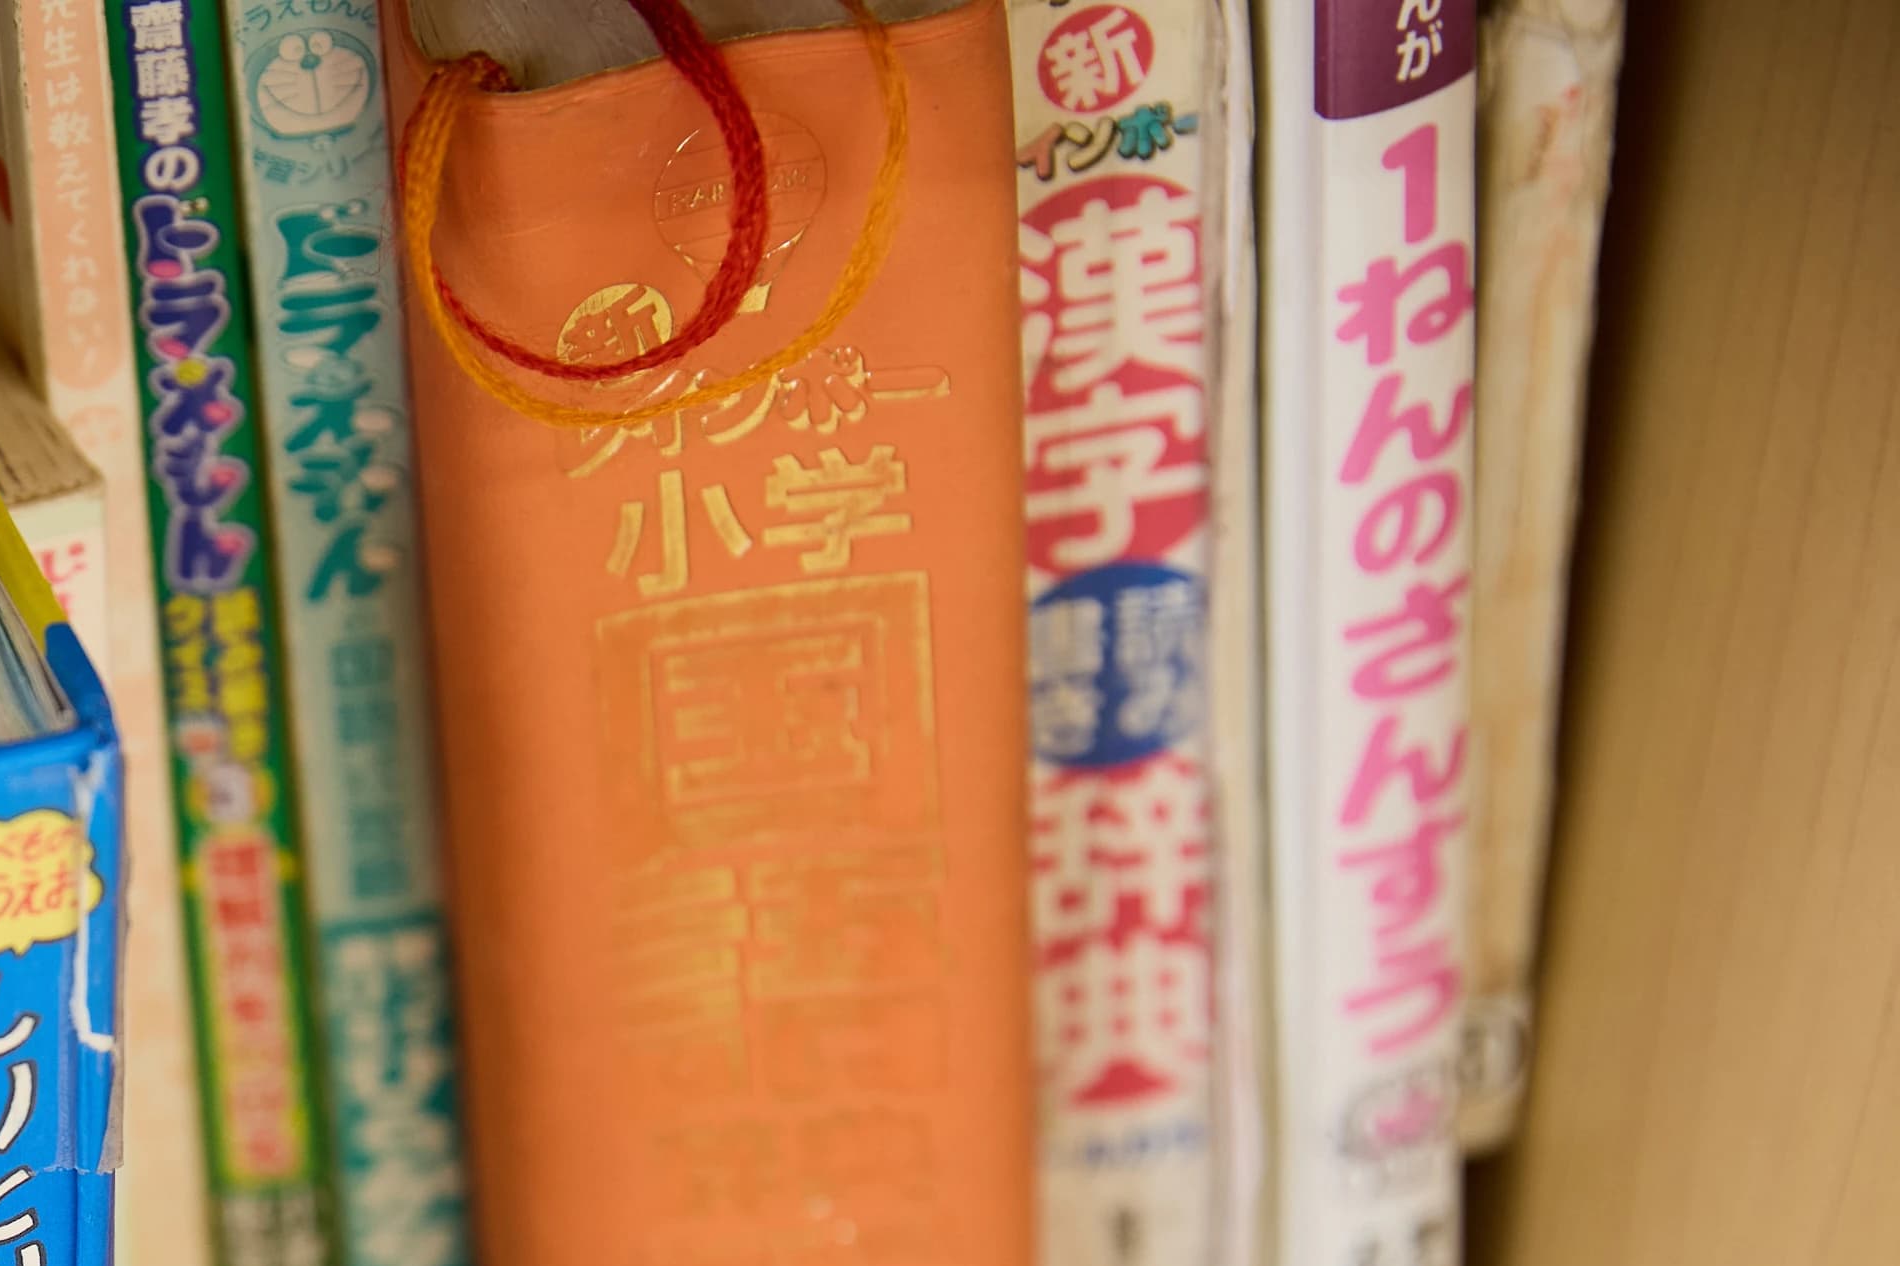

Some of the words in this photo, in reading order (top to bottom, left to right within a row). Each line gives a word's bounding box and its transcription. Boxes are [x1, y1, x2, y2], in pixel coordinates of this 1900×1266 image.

[1045, 8, 1147, 111] 新
[1020, 185, 1206, 565] 漢字
[606, 444, 912, 597] 小学
